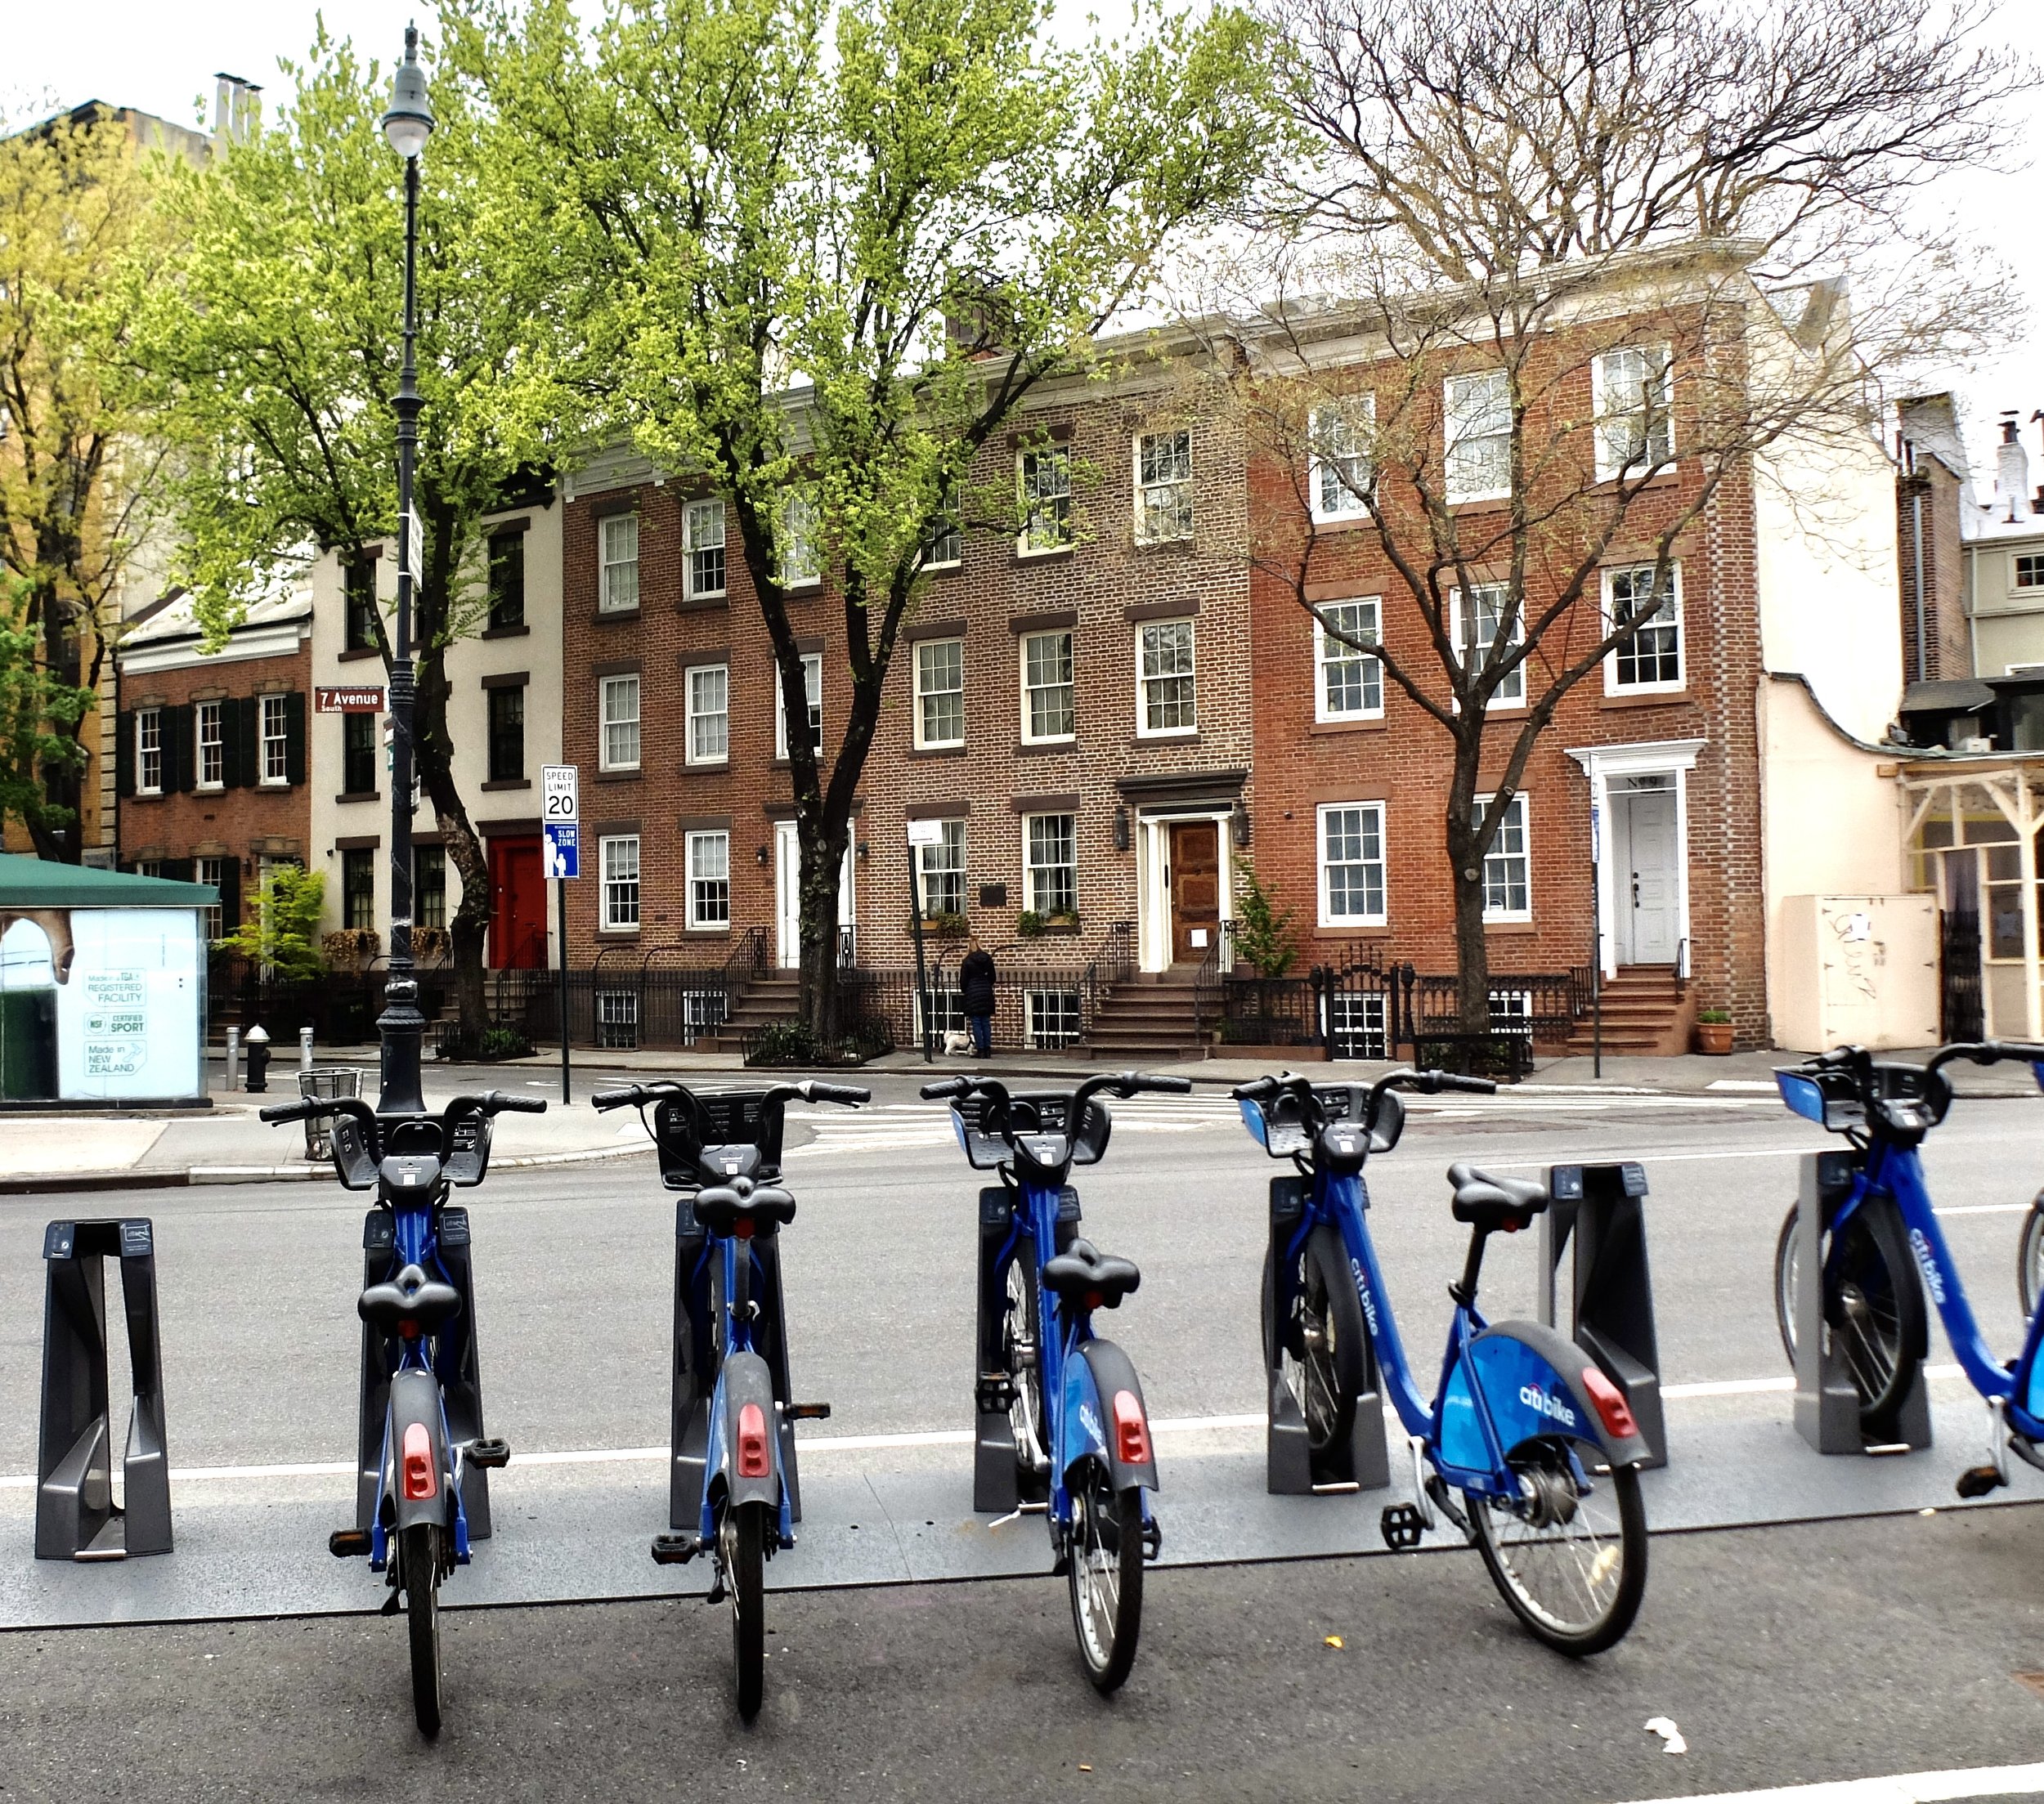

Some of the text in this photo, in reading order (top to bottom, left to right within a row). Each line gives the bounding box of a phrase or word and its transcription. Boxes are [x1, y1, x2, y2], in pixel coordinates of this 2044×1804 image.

[320, 692, 379, 705] 7 Avenue
[546, 772, 574, 781] SPEED
[549, 783, 572, 791] LIMIT
[549, 795, 574, 815] 20
[558, 830, 576, 838] SLOW
[558, 839, 576, 847] ZONE
[88, 983, 142, 992] REGISTERED
[98, 993, 142, 1002] FACILITY
[111, 1023, 144, 1032] SPORT
[88, 1045, 114, 1054] Made
[88, 1054, 111, 1063] NEW
[89, 1063, 135, 1073] ZEALAND
